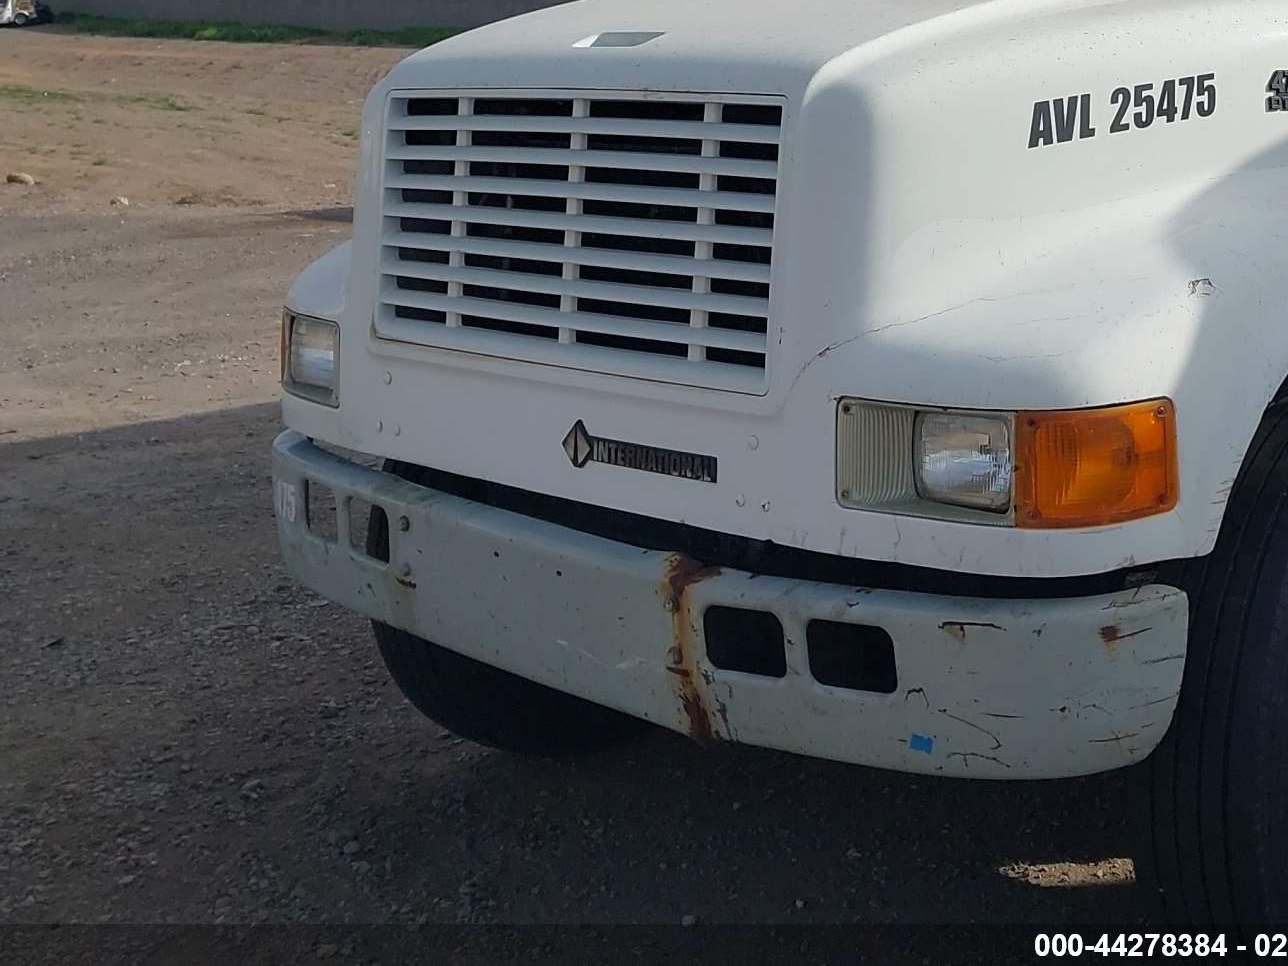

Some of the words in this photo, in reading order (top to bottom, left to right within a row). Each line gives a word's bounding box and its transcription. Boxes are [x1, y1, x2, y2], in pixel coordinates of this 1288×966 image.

[1028, 93, 1096, 149] AVL
[1108, 73, 1215, 134] 25475
[593, 440, 712, 482] INTERNATIONAL
